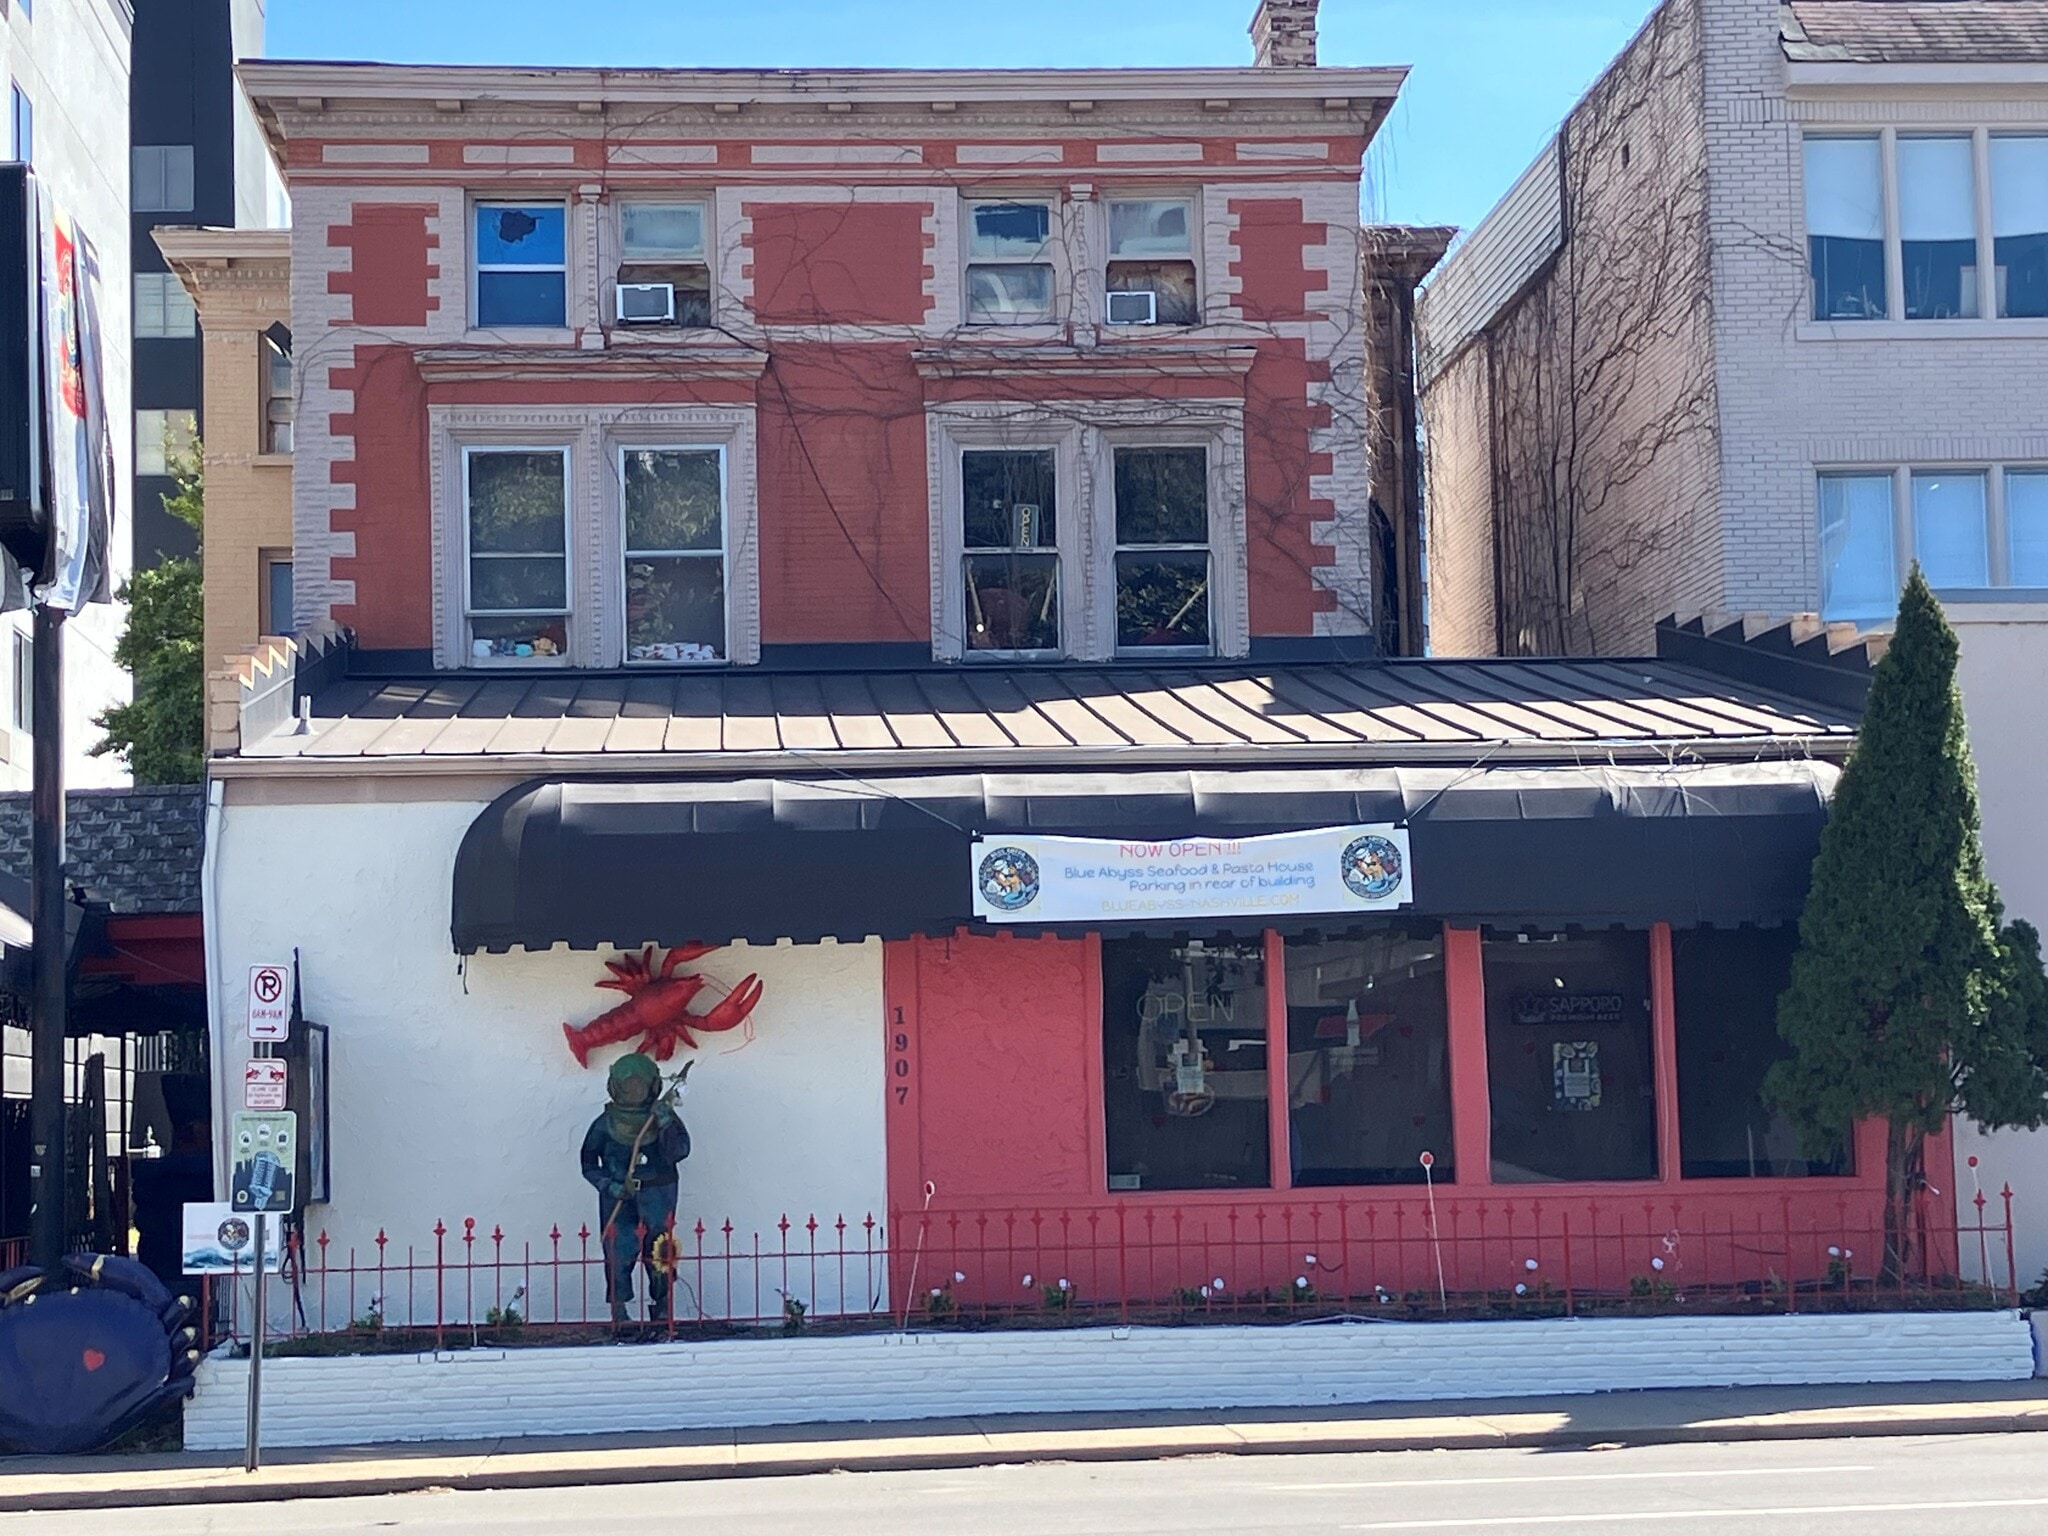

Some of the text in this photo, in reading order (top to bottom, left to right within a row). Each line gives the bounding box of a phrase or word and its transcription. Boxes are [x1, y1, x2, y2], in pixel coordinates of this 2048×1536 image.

[1021, 507, 1031, 547] OPEN
[1119, 844, 1163, 858] NOW
[1168, 842, 1222, 857] OPEN
[1064, 861, 1315, 881] Blue Abyss Seafood & Pasta House
[1129, 874, 1316, 894] Parking in rear of building
[1136, 992, 1234, 1022] OPEN
[1550, 997, 1621, 1012] SAPPORO
[894, 1006, 909, 1105] 1907
